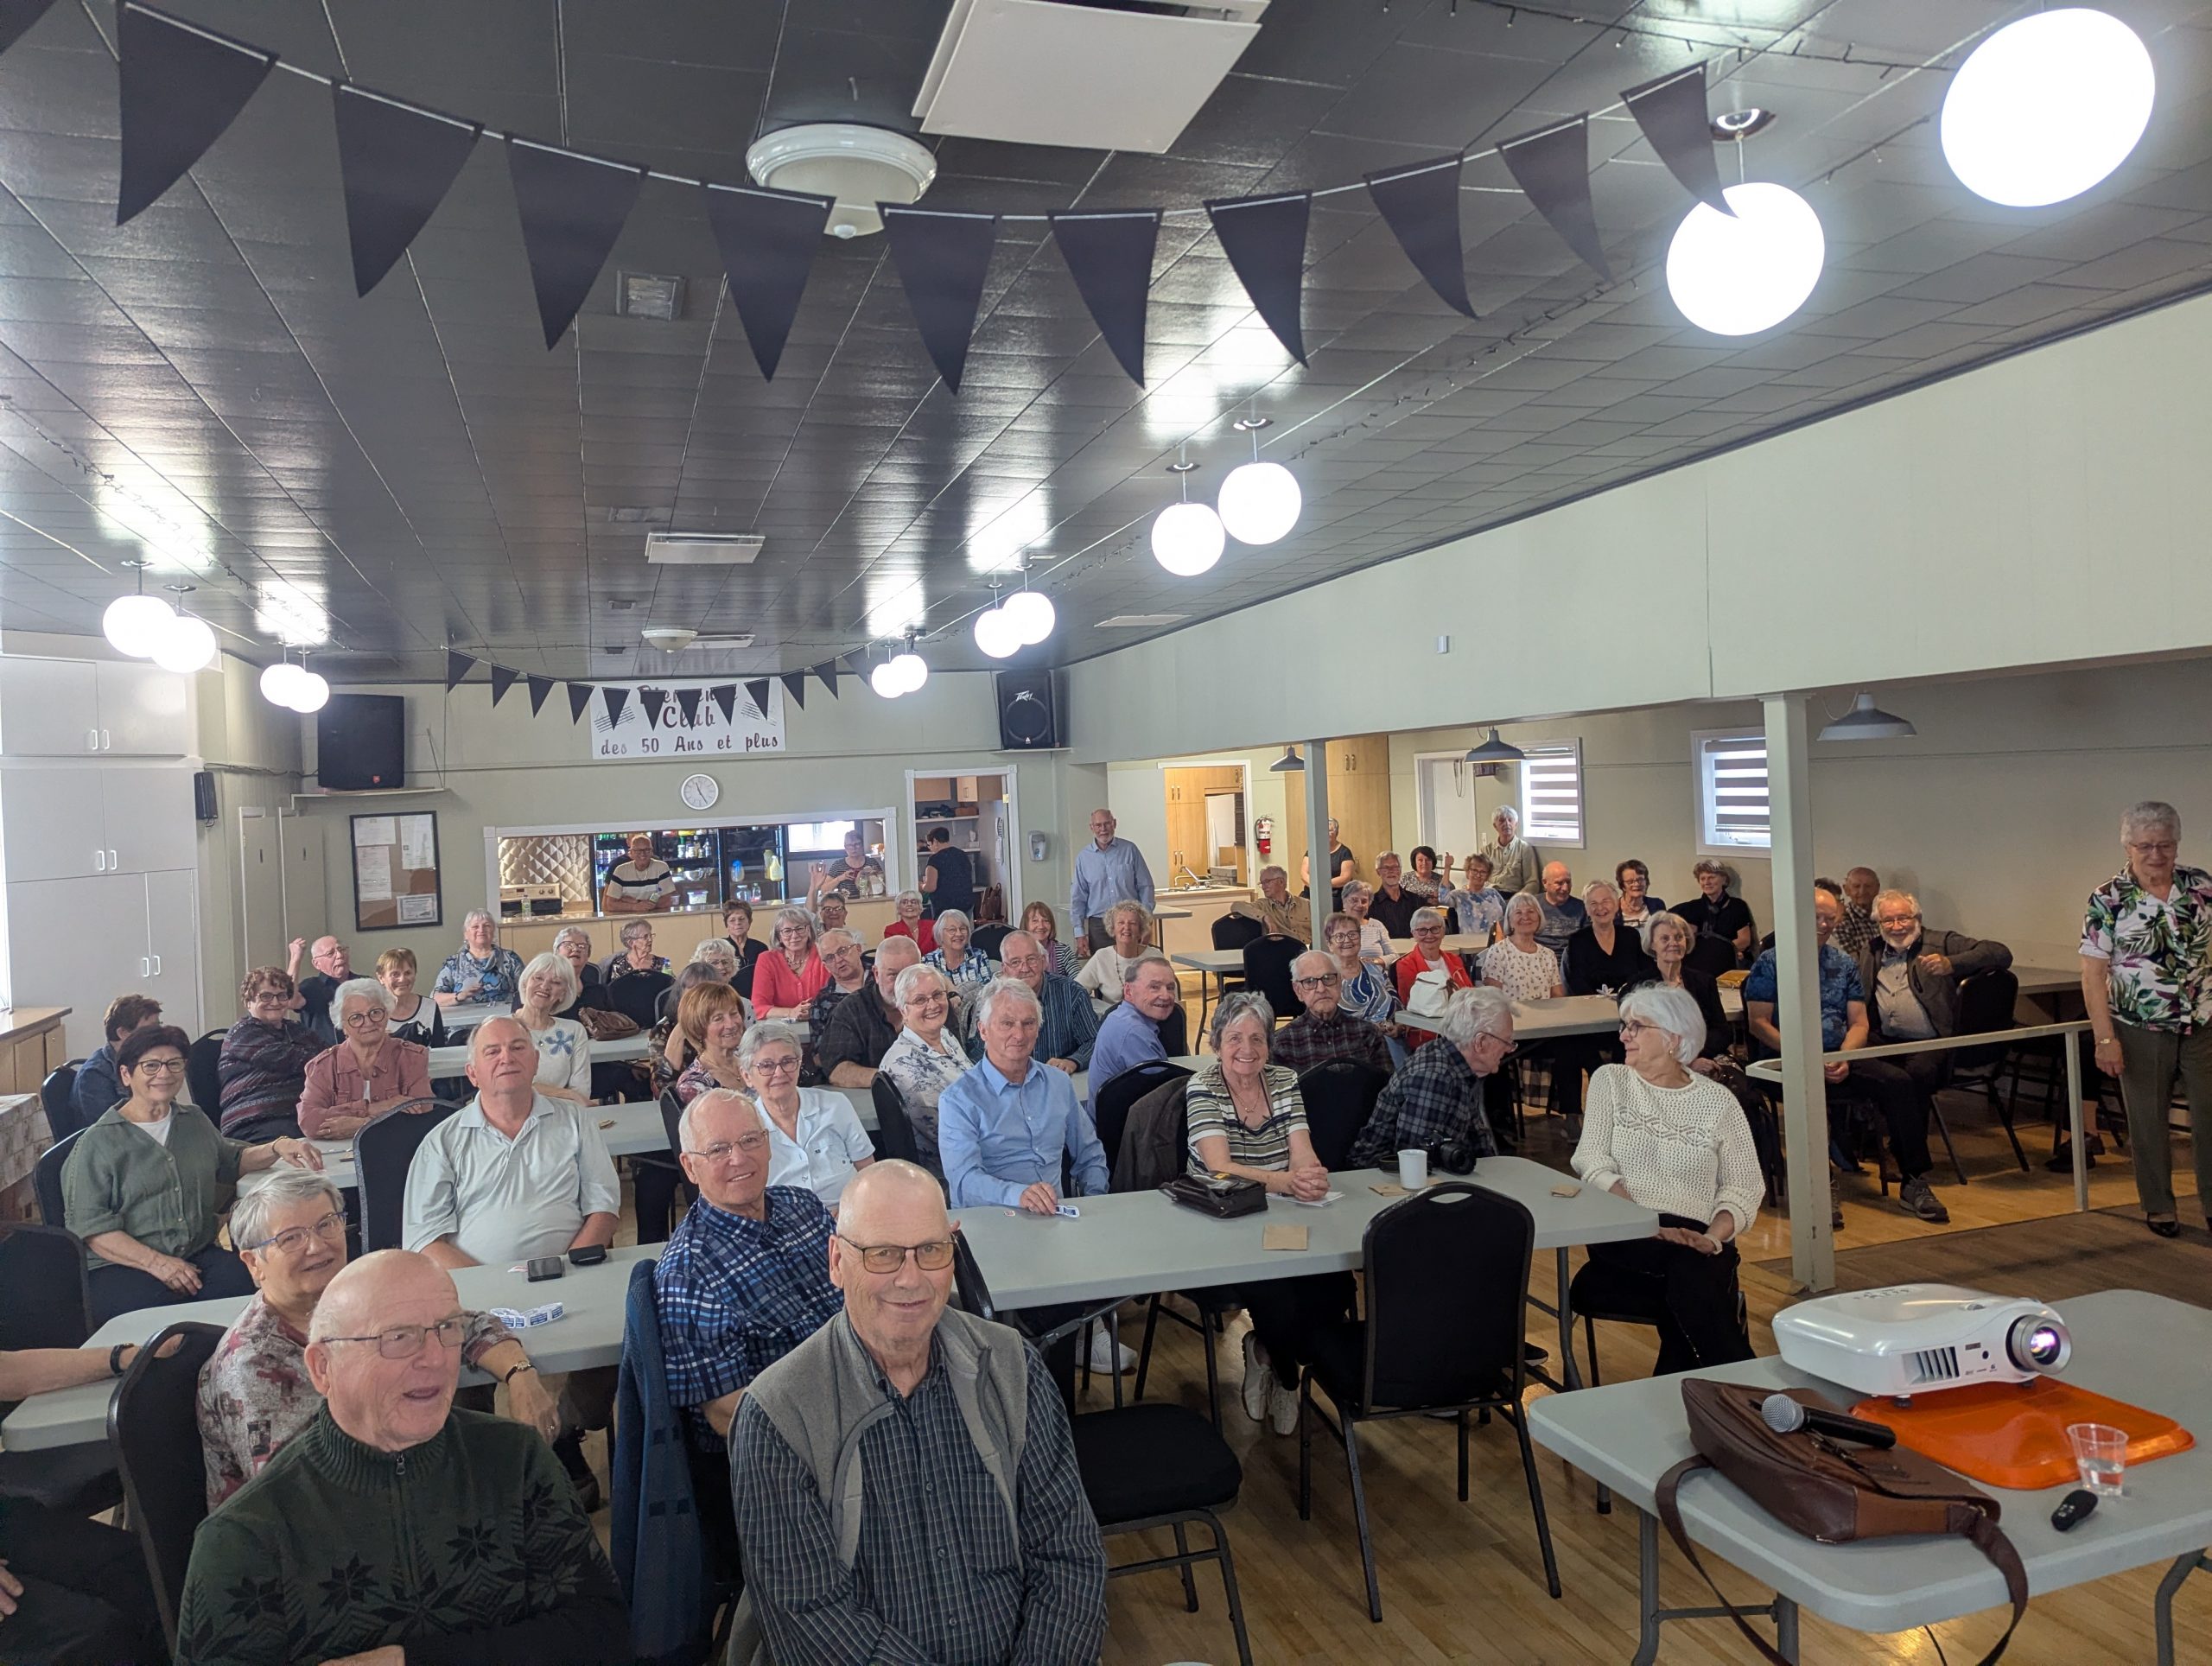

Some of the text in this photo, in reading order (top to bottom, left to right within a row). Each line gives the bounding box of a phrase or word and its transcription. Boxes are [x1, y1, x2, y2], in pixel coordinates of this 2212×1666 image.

[601, 732, 779, 755] des 50 Ans et plus
